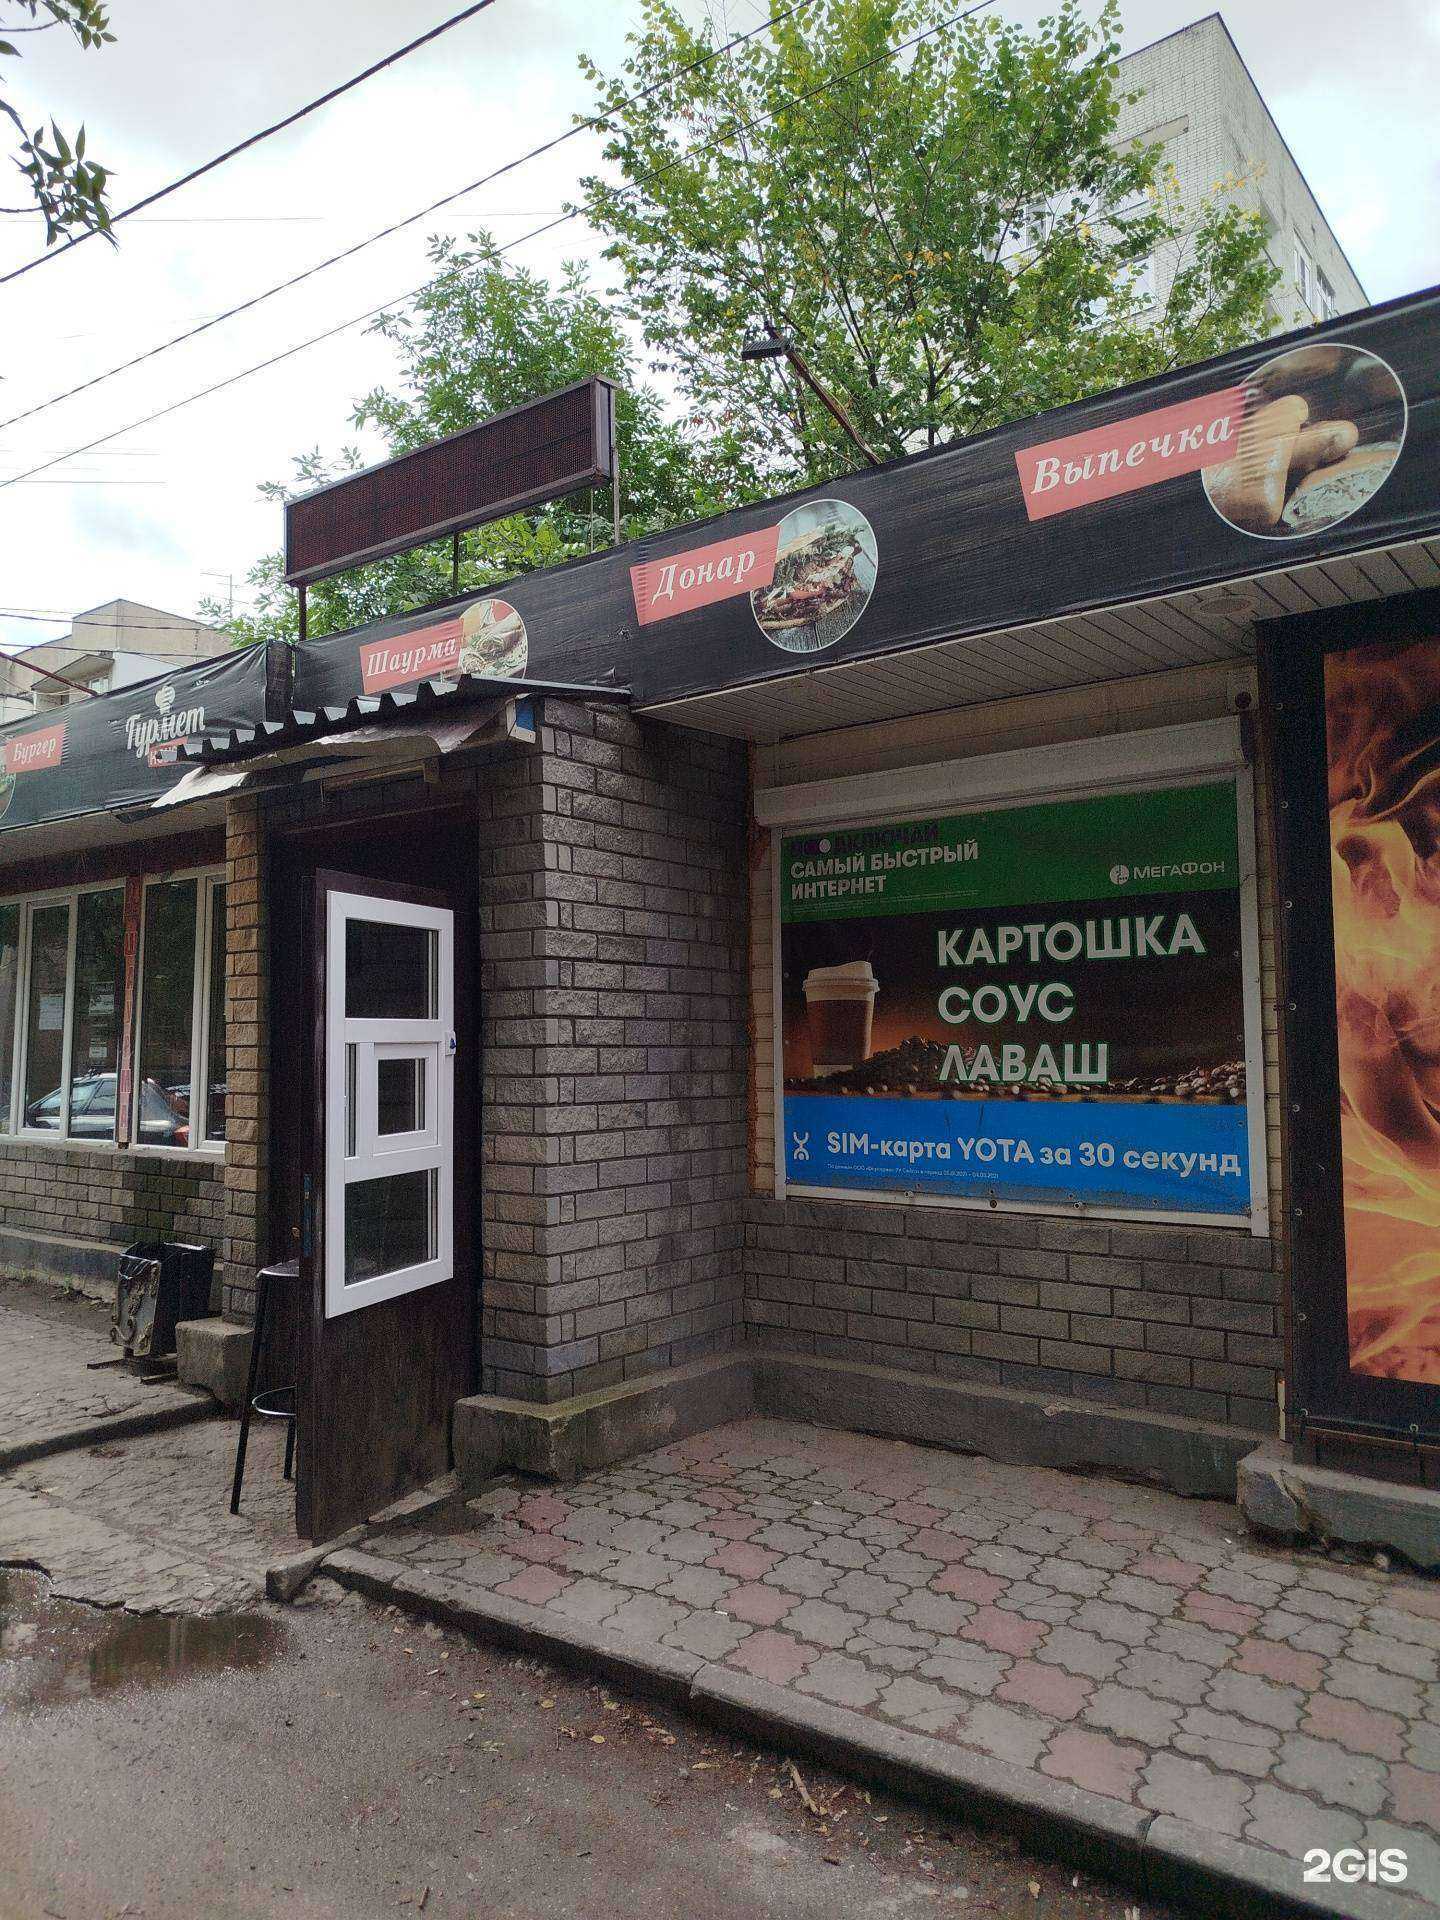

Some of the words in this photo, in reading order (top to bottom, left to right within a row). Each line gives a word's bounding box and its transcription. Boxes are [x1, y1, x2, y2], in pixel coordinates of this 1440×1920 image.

[1029, 415, 1234, 496] Выпечка
[650, 548, 755, 604] Донар
[366, 635, 458, 678] Шаурма
[12, 737, 57, 765] Бургер
[125, 706, 206, 759] Гурмет
[790, 849, 866, 879] САМЫЙ
[870, 838, 979, 870] БЫСТРЫЙ
[1133, 861, 1226, 880] МЕГАФОН
[791, 875, 887, 900] ИНТЕРНЕТ
[937, 913, 1207, 966] КАРТОШКА
[937, 982, 1075, 1024] СОУС
[938, 1043, 1108, 1082] ЛАВАШ
[827, 1132, 951, 1164] SIM-карта
[957, 1137, 1035, 1164] YOTA
[1039, 1147, 1072, 1166] за
[1078, 1141, 1115, 1168] 30
[1123, 1150, 1242, 1178] секунд
